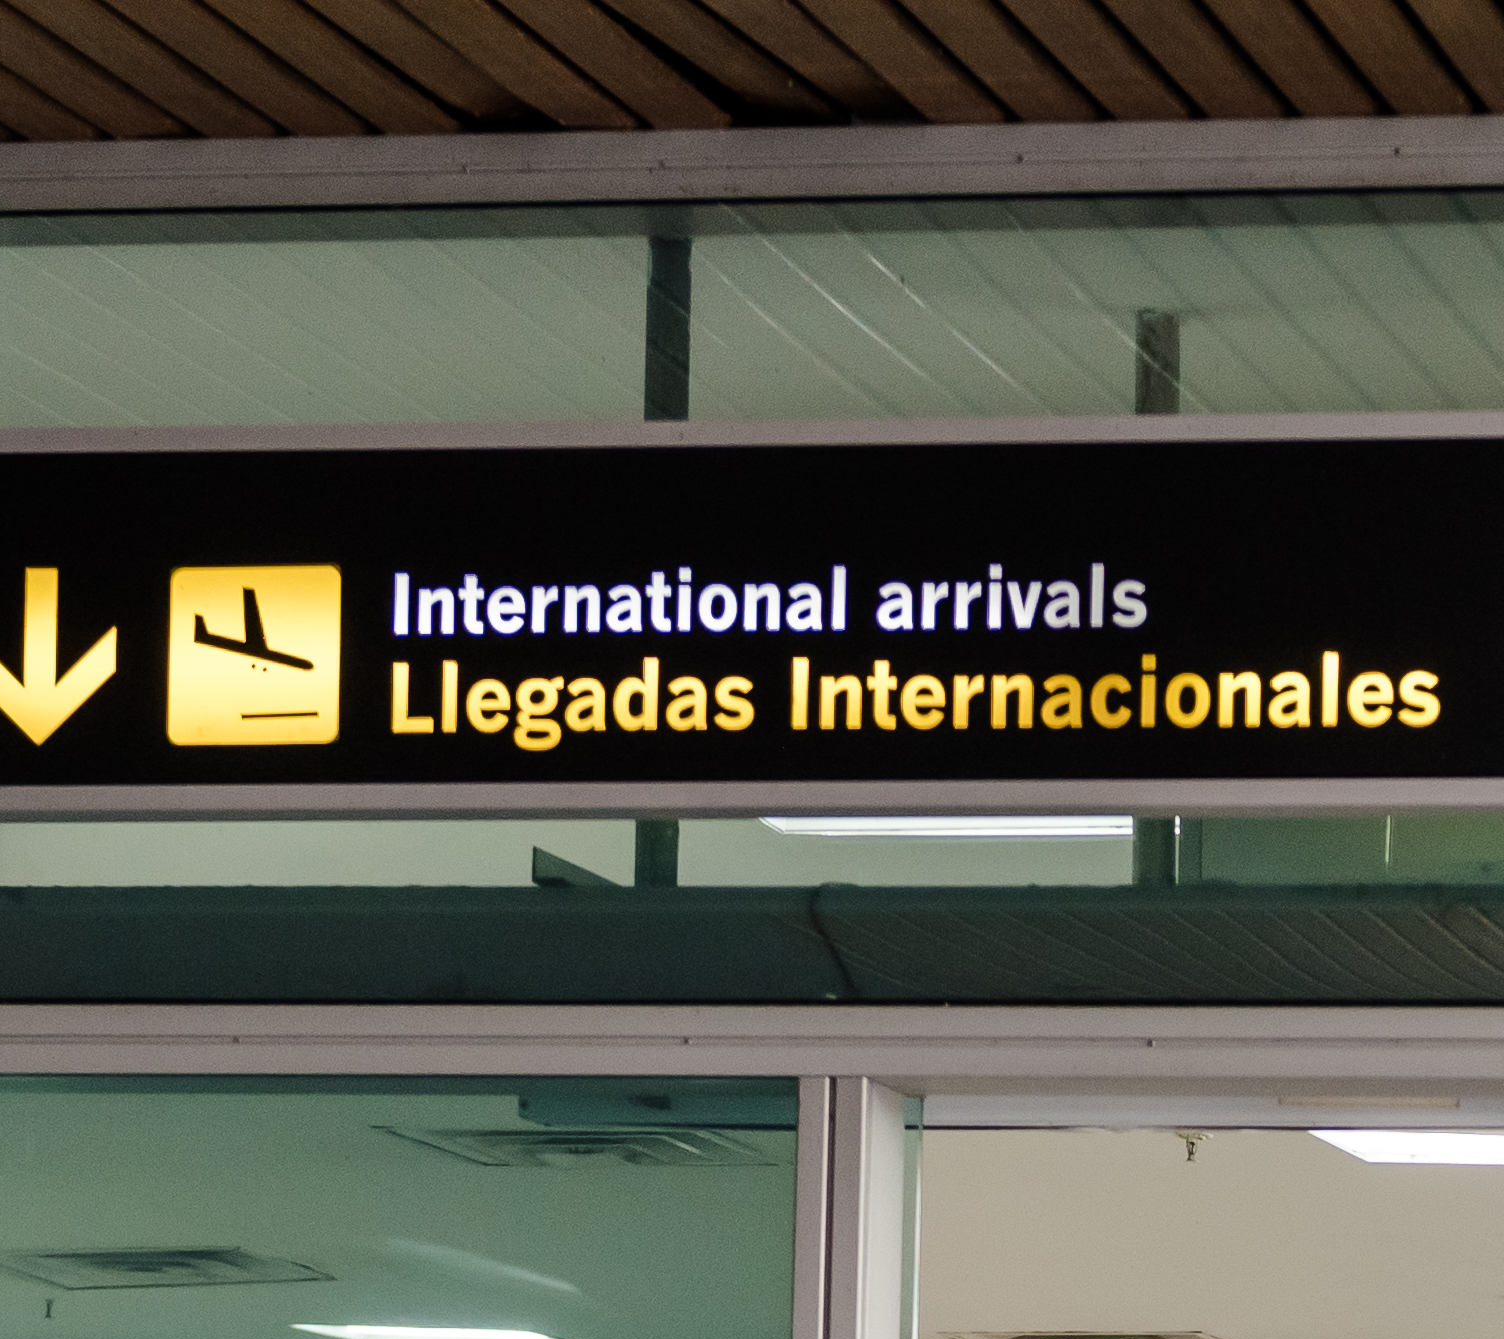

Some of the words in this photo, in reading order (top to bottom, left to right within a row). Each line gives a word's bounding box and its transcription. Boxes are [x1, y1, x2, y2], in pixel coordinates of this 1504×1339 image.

[392, 565, 847, 637] International
[876, 563, 1148, 632] arrivals
[391, 657, 754, 751] Llegadas
[791, 651, 1442, 731] Internacionales
